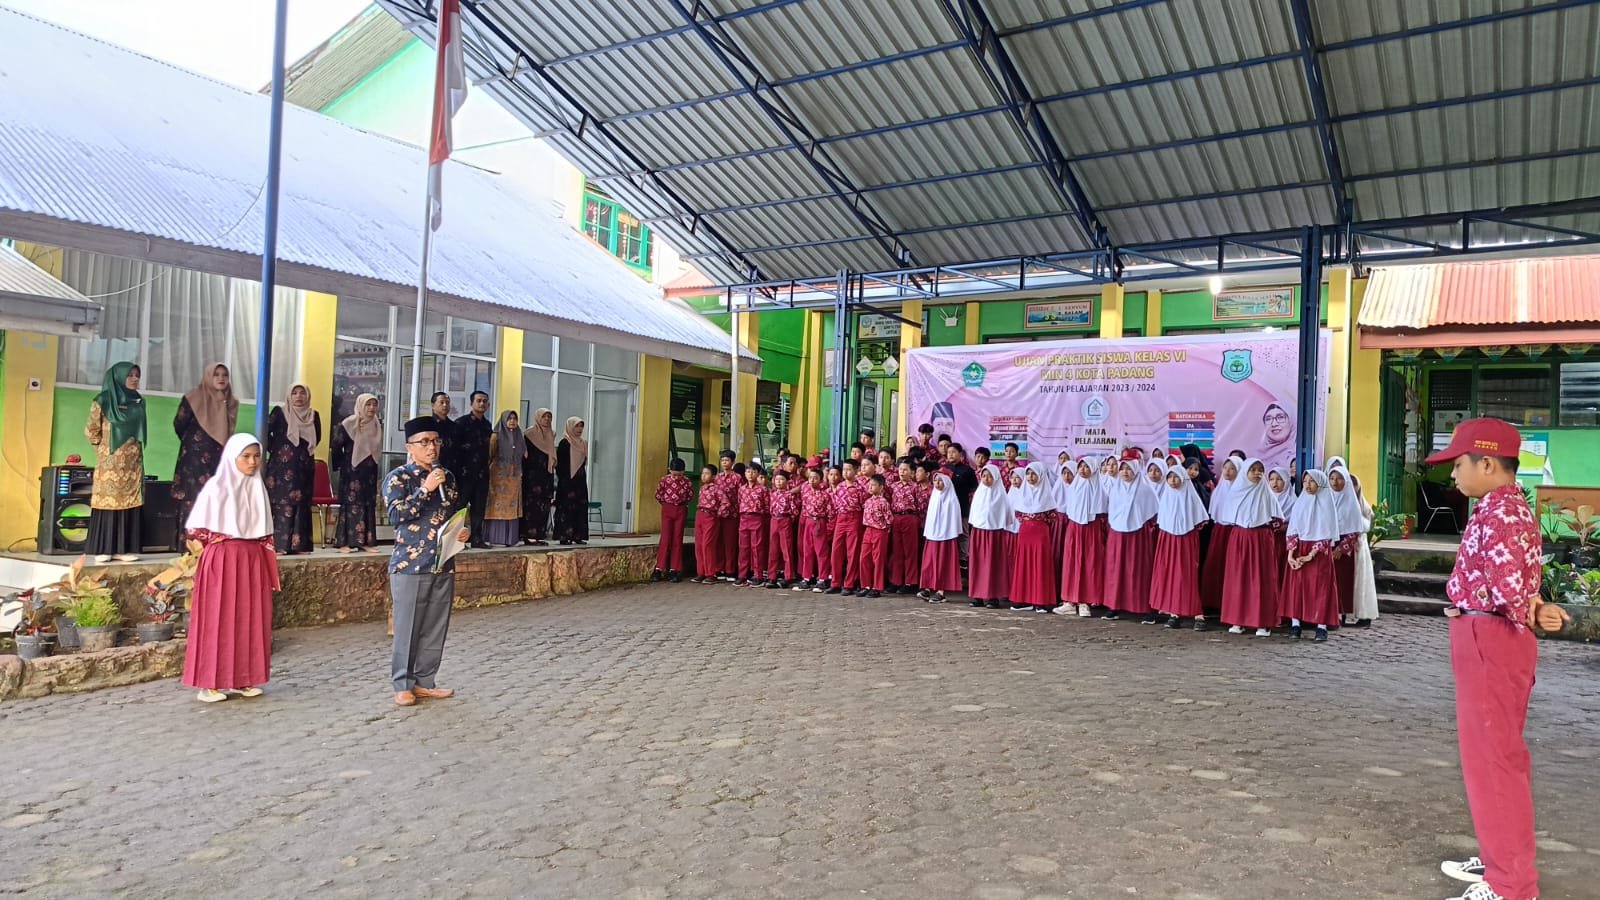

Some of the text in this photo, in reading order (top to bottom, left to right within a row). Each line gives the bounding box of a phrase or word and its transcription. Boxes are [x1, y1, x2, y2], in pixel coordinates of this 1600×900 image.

[1014, 350, 1187, 367] UJIAN PRAKTIK SISWA KELAS VI
[1040, 367, 1155, 380] MIN 4 KOTA PADANG
[1040, 385, 1064, 393] TAHUN
[1066, 384, 1109, 393] PELAJARAN
[1111, 384, 1129, 392] 2023
[1137, 383, 1156, 392] 2024
[1085, 428, 1106, 436] MATA
[1075, 437, 1117, 445] PELAJARAN
